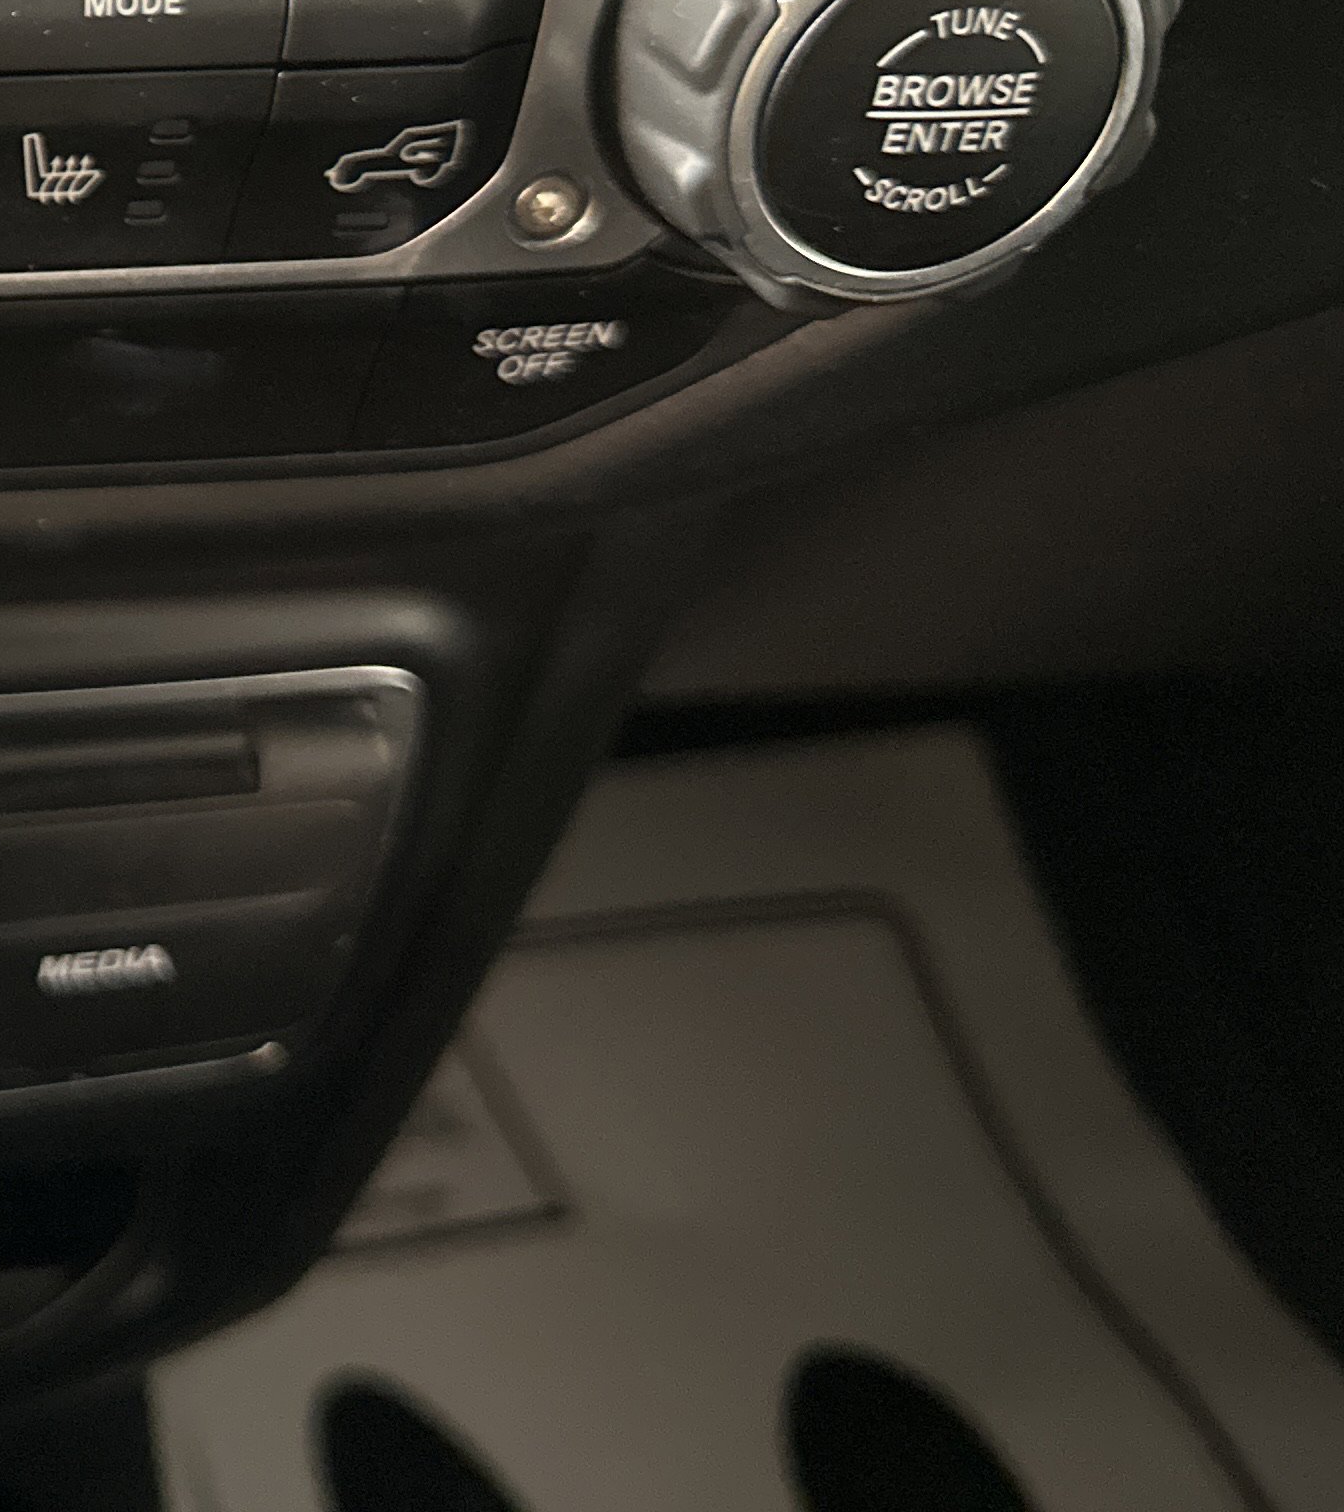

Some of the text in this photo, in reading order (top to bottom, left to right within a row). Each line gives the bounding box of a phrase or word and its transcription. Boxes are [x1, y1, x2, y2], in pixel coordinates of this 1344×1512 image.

[929, 7, 1021, 43] TUNE
[871, 71, 1039, 108] BROWSE
[881, 120, 1011, 155] ENTER
[863, 177, 987, 213] SCROLL
[472, 320, 621, 356] SCREEN
[497, 351, 576, 384] OFF
[38, 943, 175, 991] MEDIA
